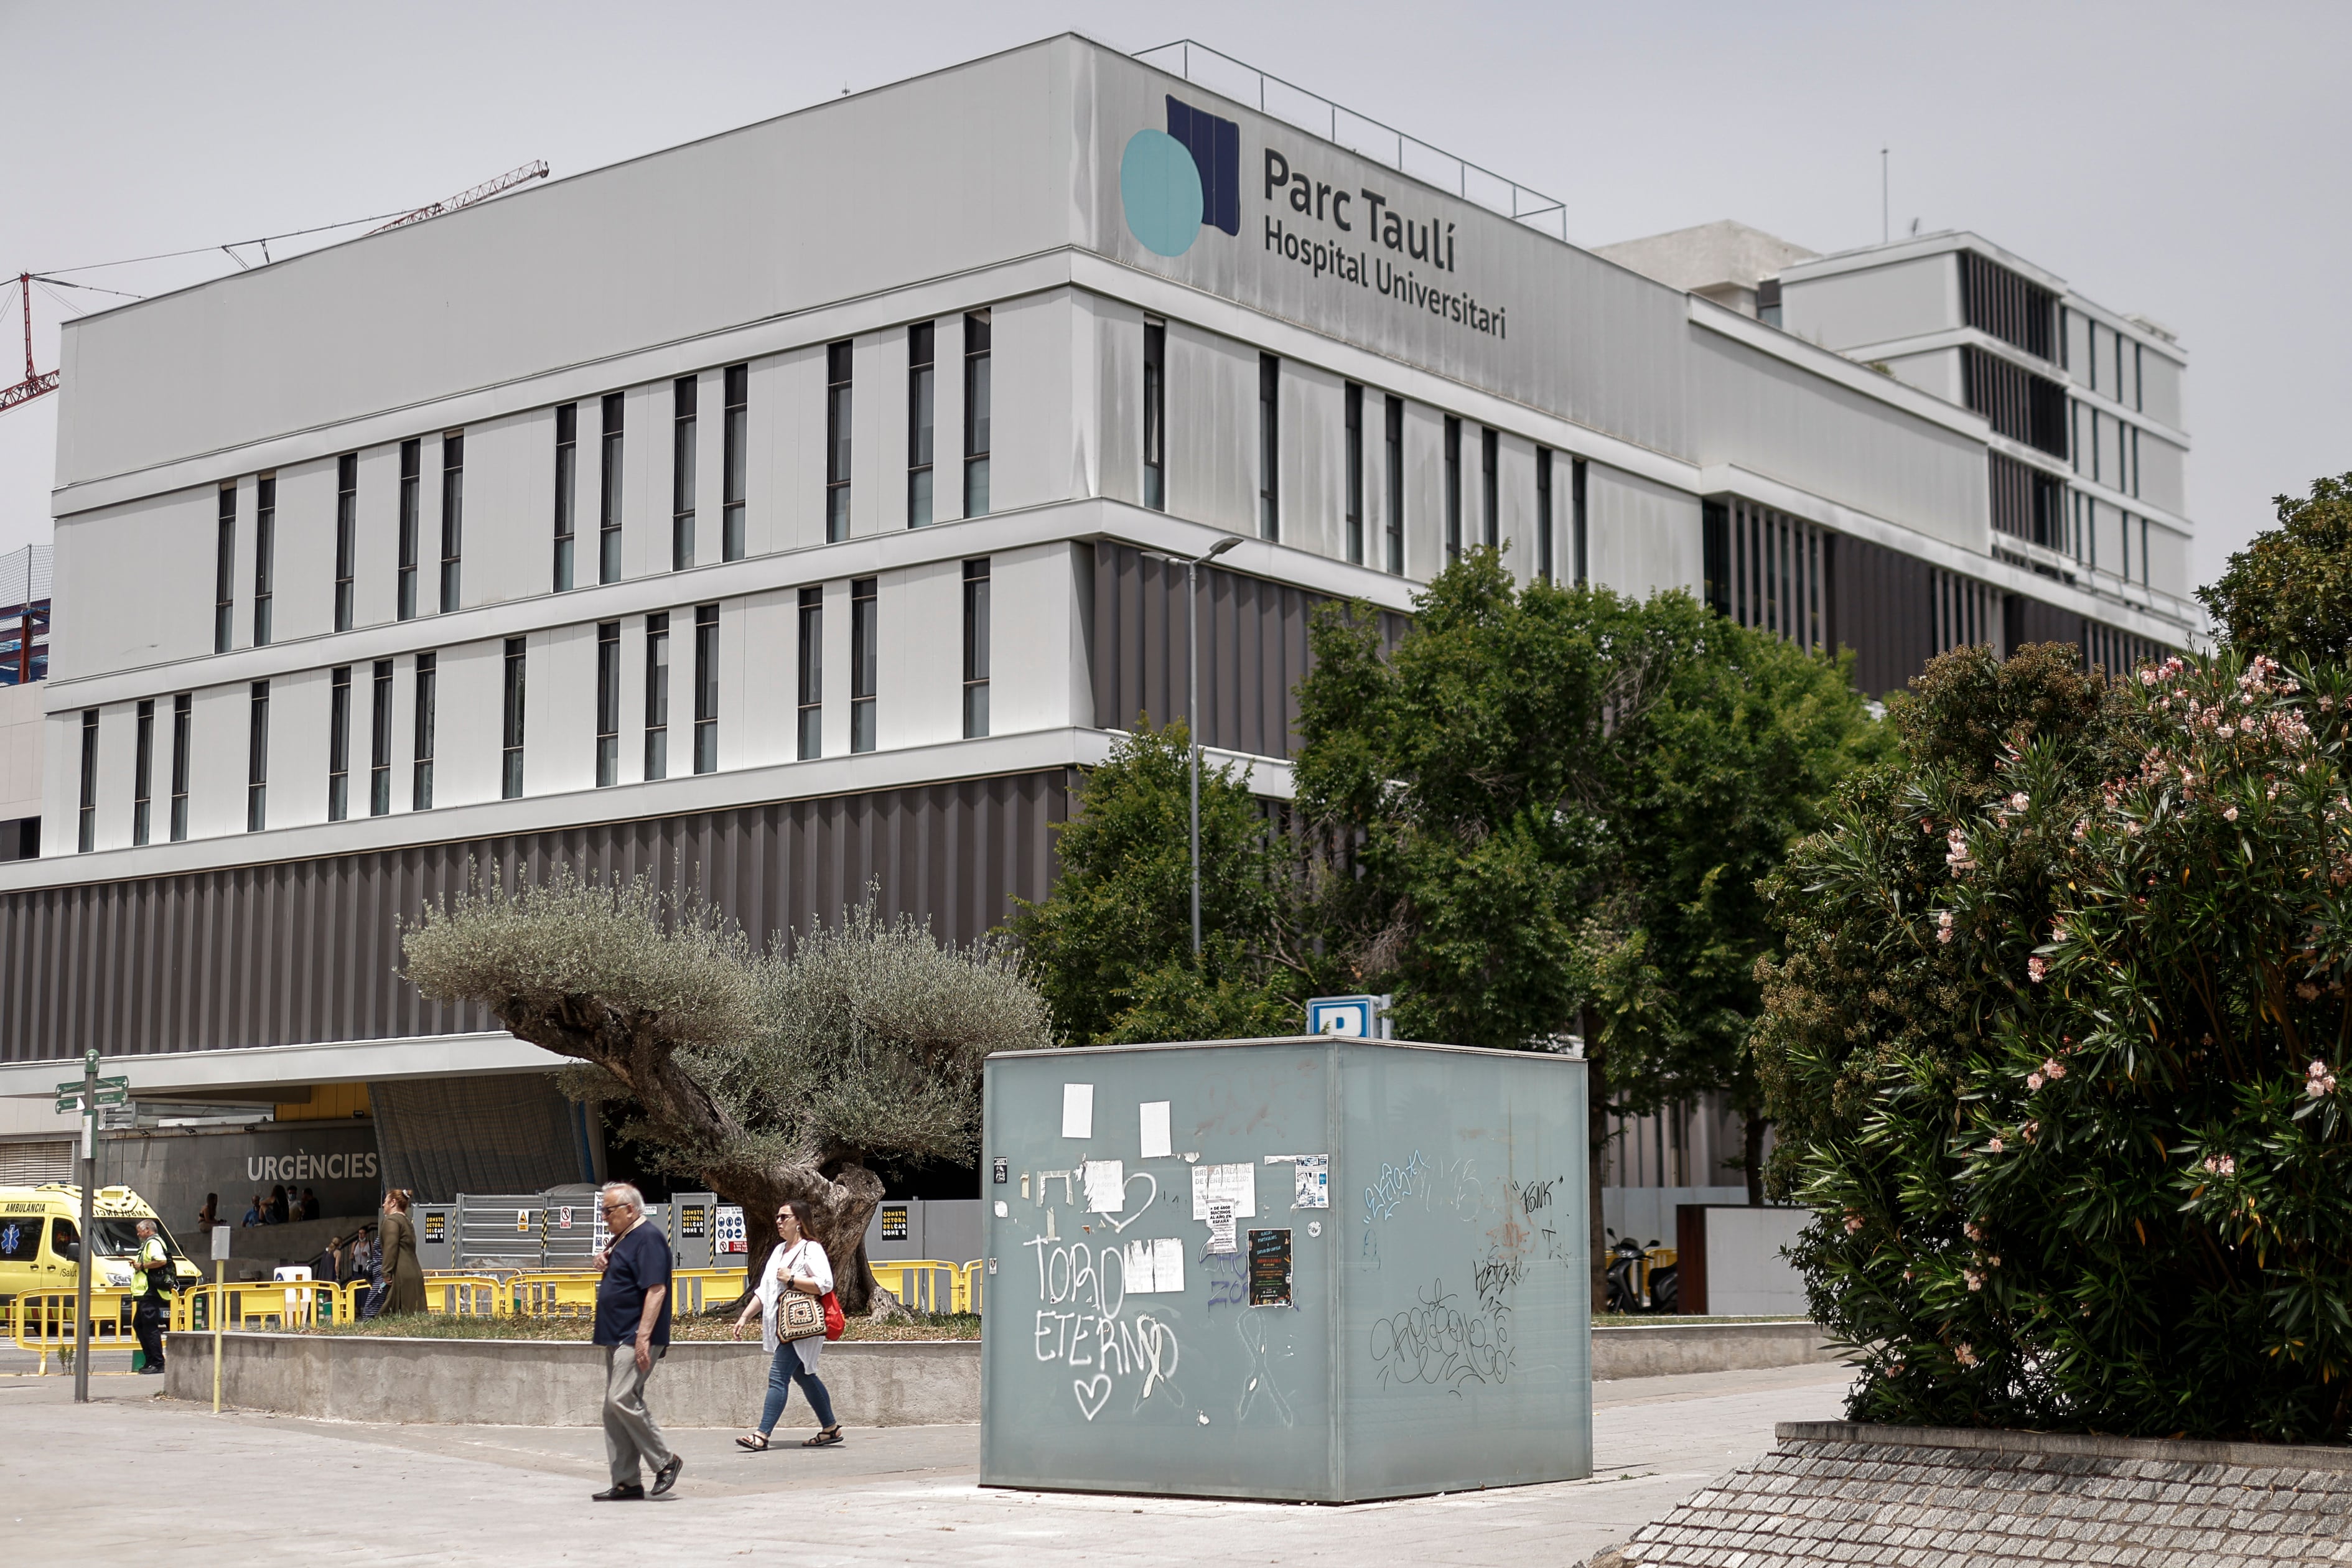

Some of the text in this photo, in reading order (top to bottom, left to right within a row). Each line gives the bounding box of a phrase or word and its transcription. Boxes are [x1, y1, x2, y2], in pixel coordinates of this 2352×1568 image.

[1264, 147, 1455, 272] Parc Taulí
[1265, 215, 1506, 340] Hospital Universitari
[248, 1148, 377, 1181] URGÈNCIES
[1024, 1234, 1124, 1320] TORO
